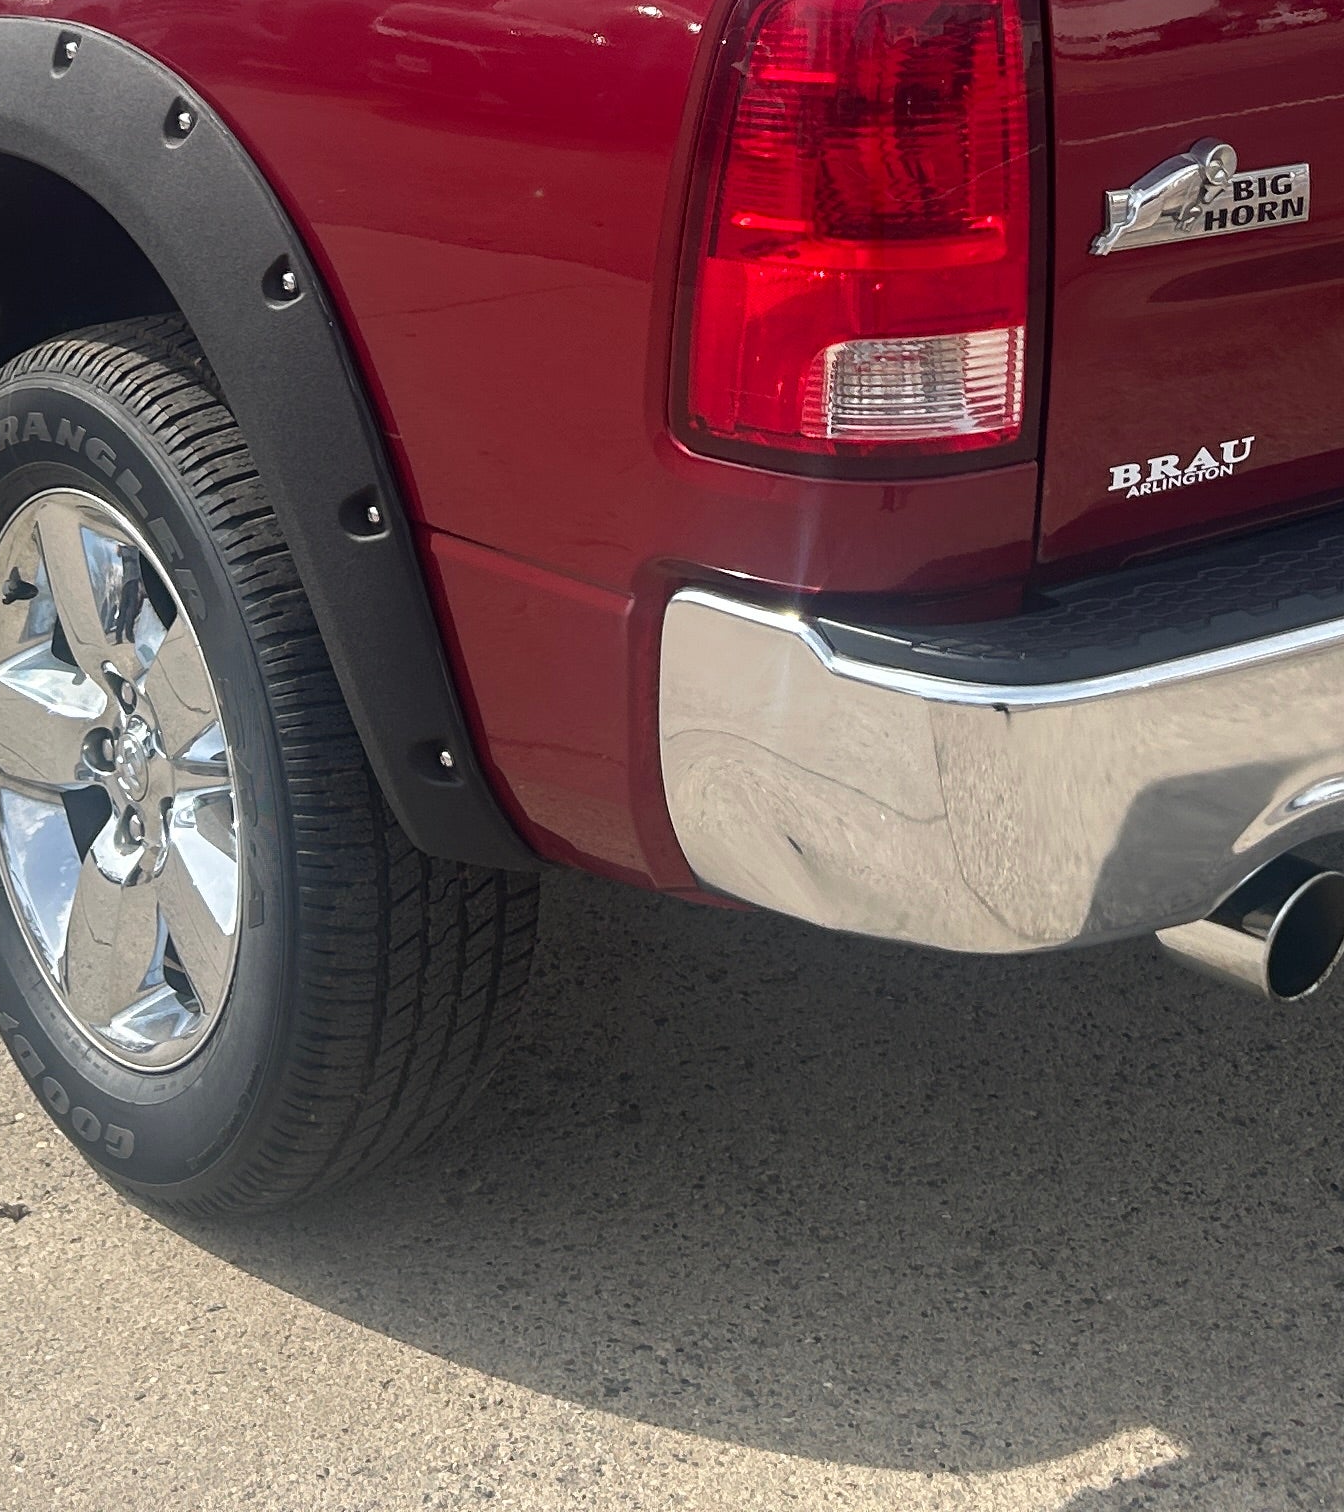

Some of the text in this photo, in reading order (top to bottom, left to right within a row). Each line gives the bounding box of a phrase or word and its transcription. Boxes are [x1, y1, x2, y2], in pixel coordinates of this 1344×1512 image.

[1232, 173, 1293, 202] BIG
[1204, 196, 1305, 232] HORN
[1108, 435, 1256, 492] BRAU
[1126, 463, 1234, 499] ARLINGTON
